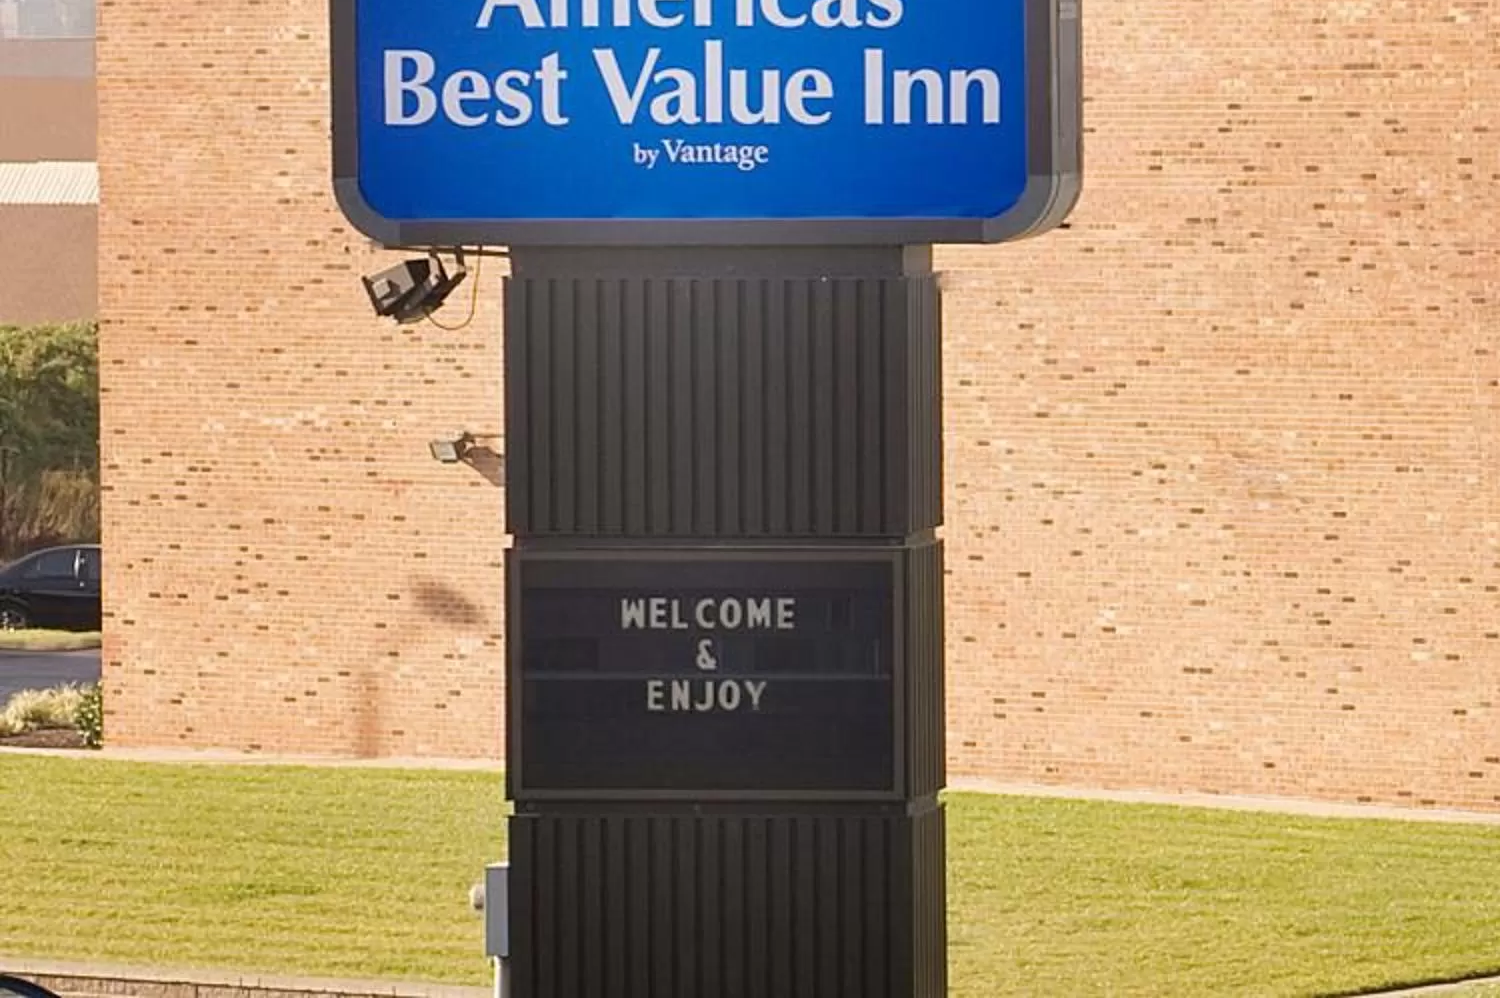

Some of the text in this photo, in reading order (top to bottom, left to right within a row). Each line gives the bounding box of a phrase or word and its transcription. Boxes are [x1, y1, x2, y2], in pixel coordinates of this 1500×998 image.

[383, 40, 1001, 126] Best Value Inn
[633, 139, 769, 170] by Vantage
[620, 598, 795, 629] WELCOME
[695, 639, 718, 671] &
[646, 679, 767, 712] ENJOY
